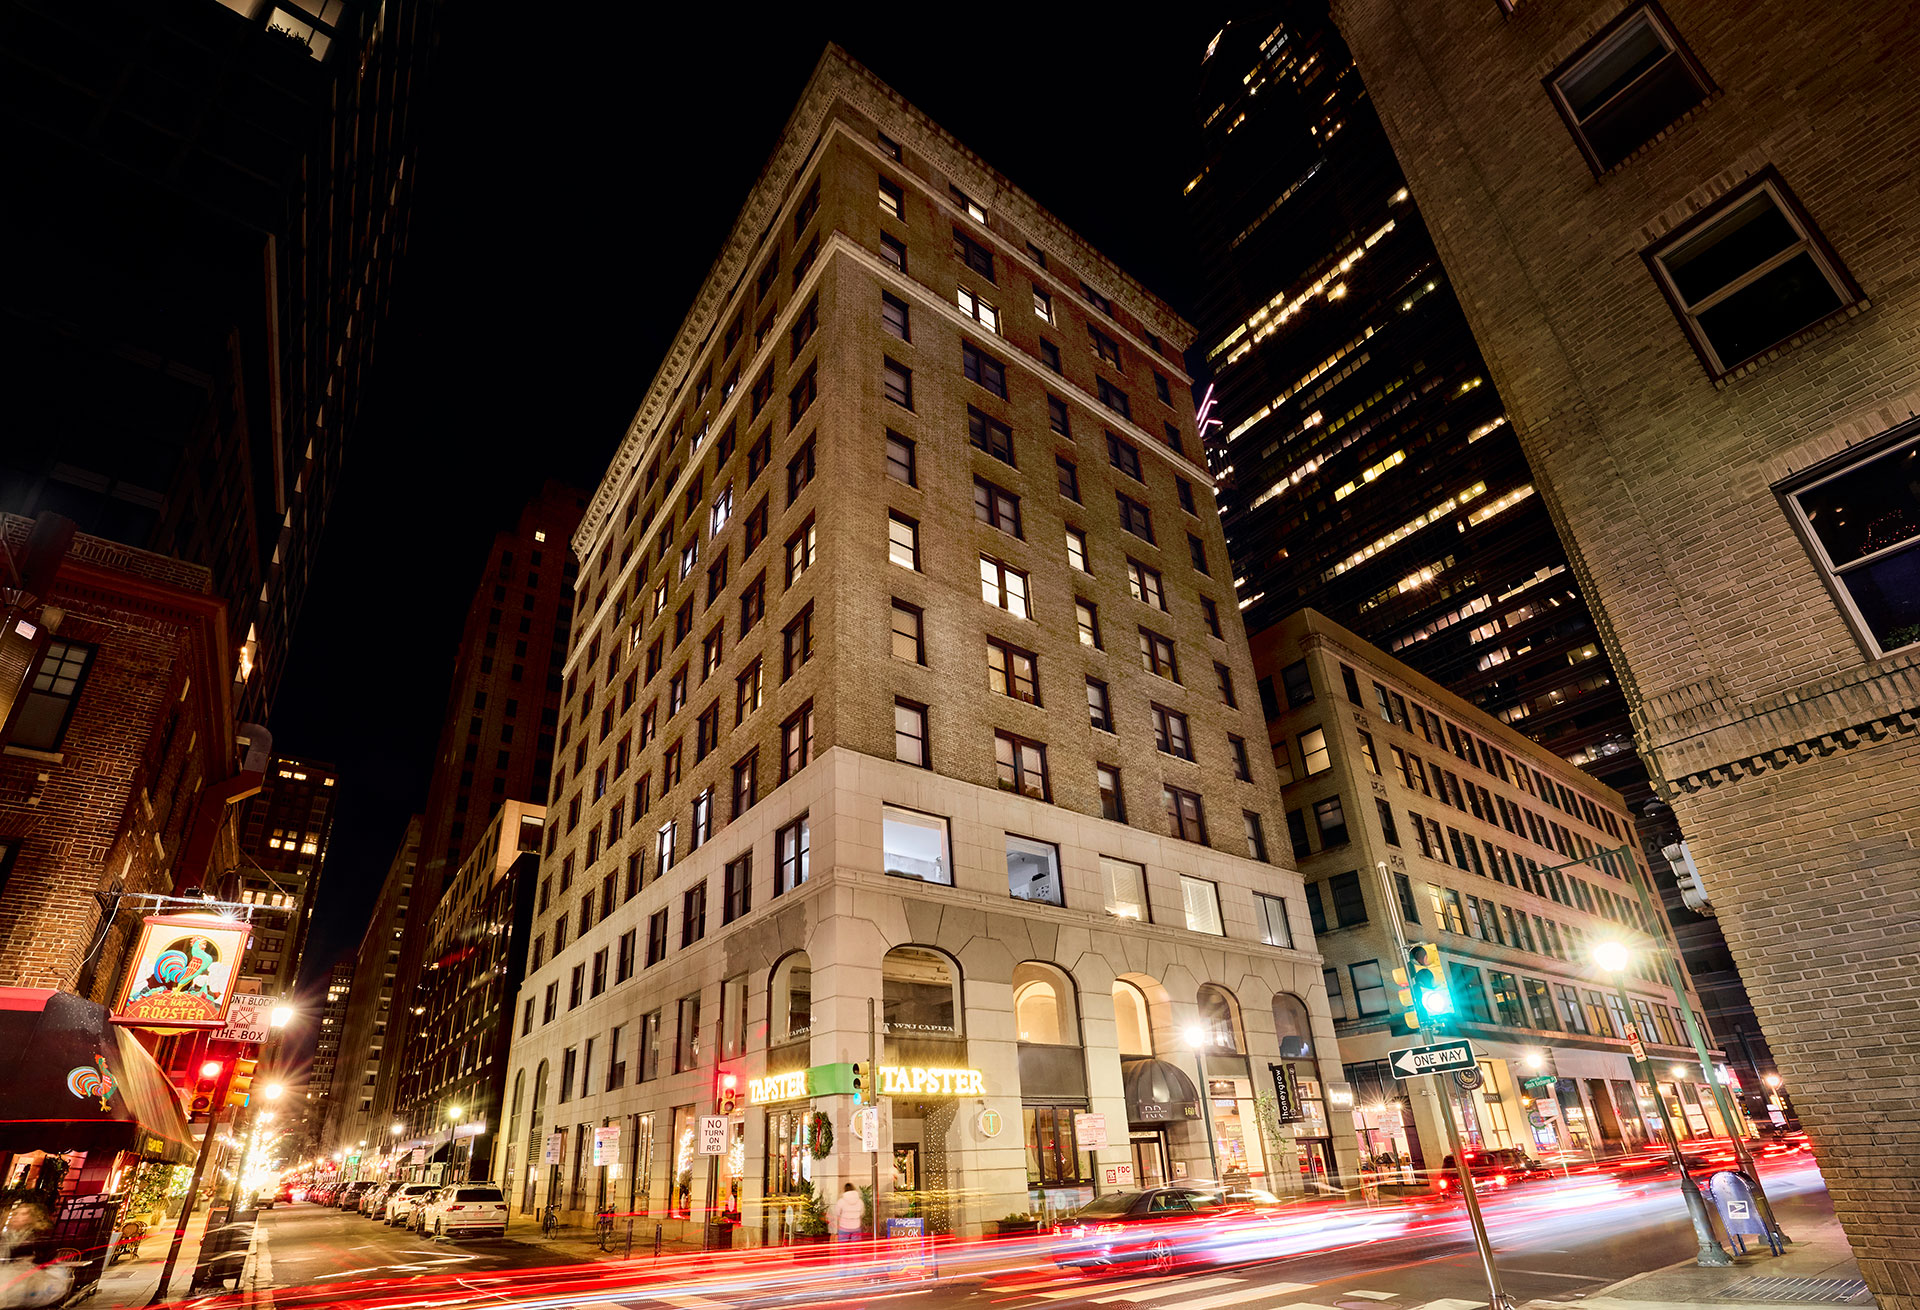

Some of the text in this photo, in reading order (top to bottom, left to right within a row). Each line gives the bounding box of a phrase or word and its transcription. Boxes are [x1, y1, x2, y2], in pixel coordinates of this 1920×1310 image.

[170, 999, 199, 1008] HAPPY
[249, 997, 275, 1007] BLOCK
[139, 1006, 206, 1021] ROOSTER
[918, 1024, 956, 1032] CAPITA
[215, 1029, 264, 1041] THE BOX
[1413, 1049, 1462, 1067] ONE WAY
[879, 1066, 986, 1094] TAPSTER
[749, 1071, 807, 1103] TAPSTER
[1275, 1069, 1289, 1117] honeygrow
[707, 1119, 722, 1129] NO
[983, 1113, 998, 1133] T
[704, 1129, 725, 1137] TURN
[708, 1136, 720, 1144] ON
[706, 1144, 722, 1152] RED
[1117, 1166, 1130, 1174] FDC
